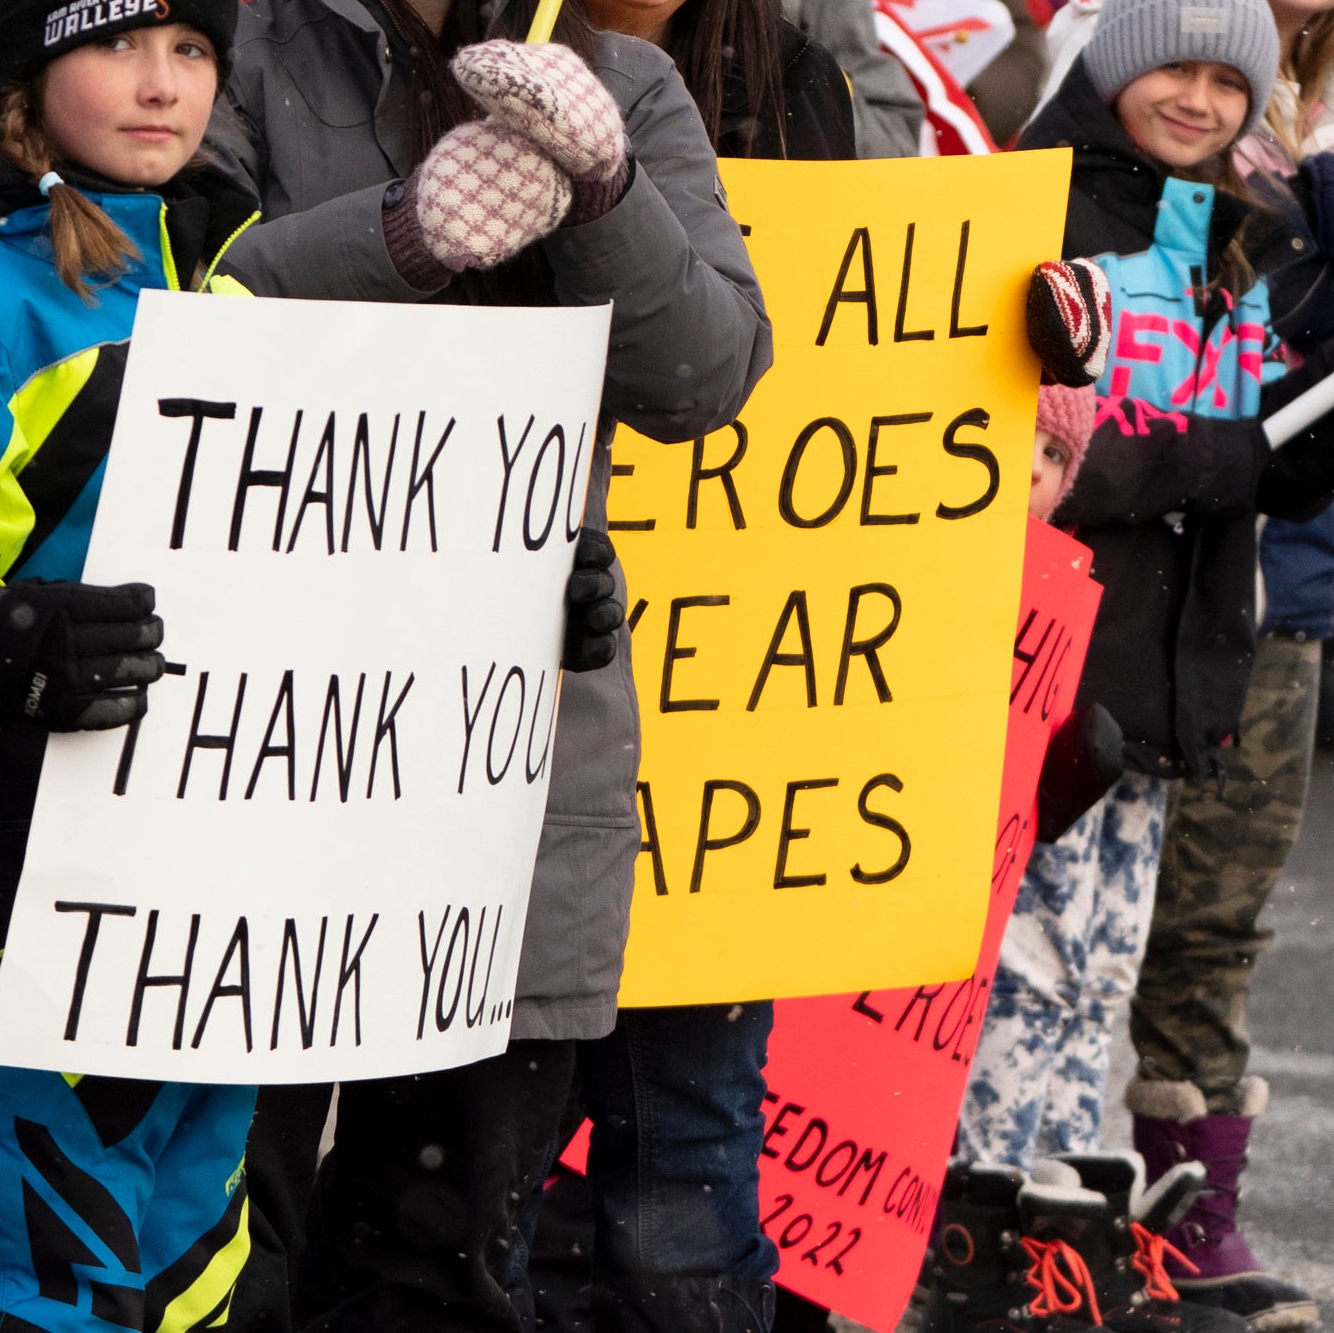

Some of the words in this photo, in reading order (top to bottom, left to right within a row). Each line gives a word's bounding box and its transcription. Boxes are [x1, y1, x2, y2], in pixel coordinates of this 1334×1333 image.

[815, 219, 988, 346] ALL
[157, 397, 456, 555] THANK
[628, 582, 903, 713] EAR
[457, 661, 562, 795] YOU
[55, 900, 380, 1053] THANK
[760, 1194, 862, 1277] 2022
